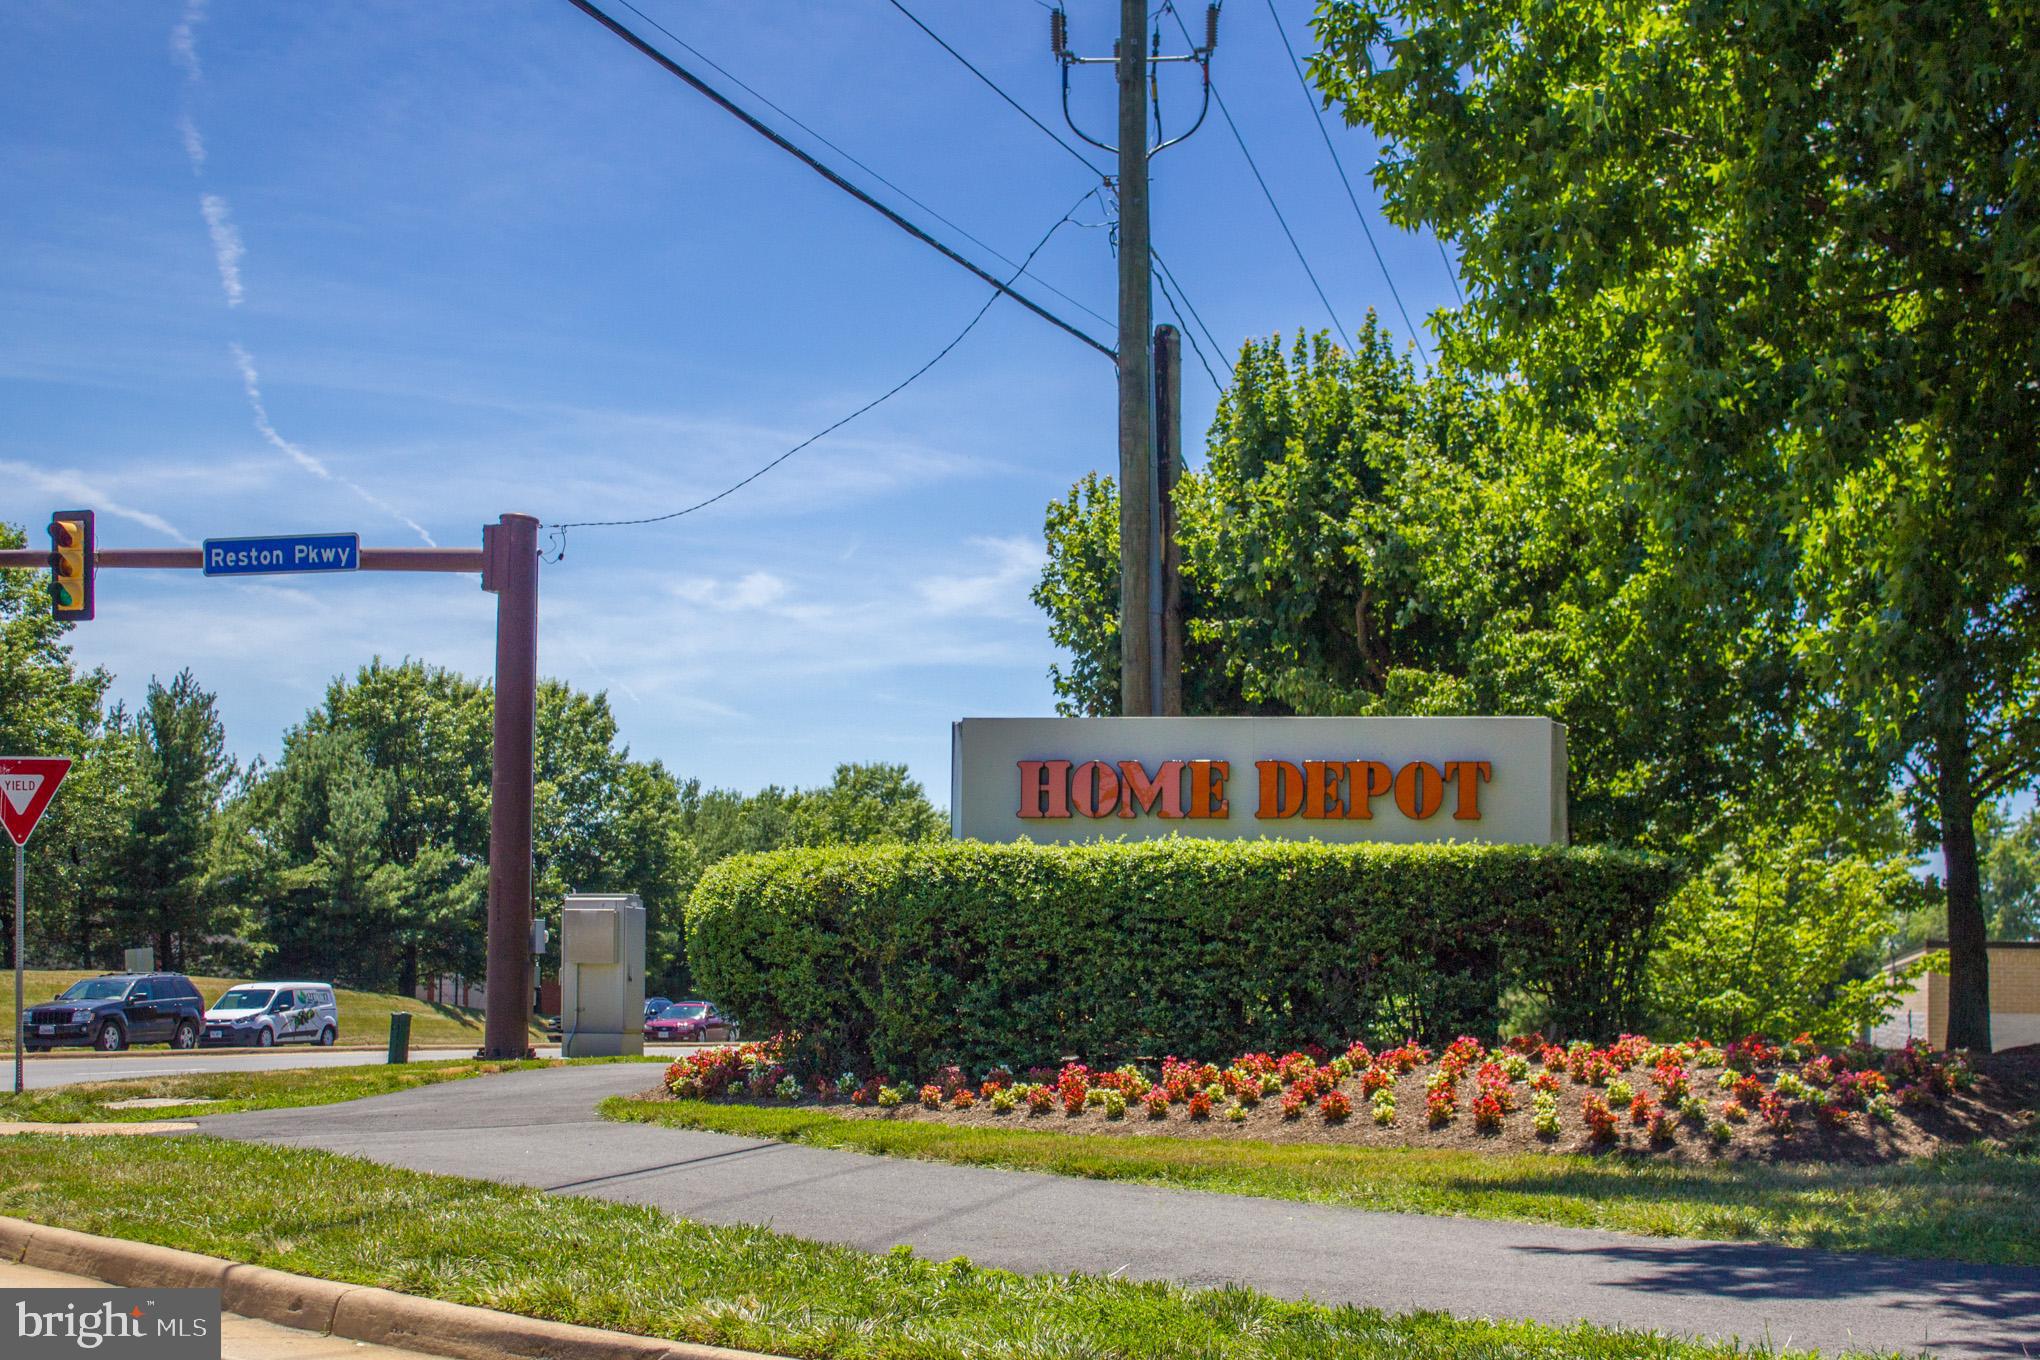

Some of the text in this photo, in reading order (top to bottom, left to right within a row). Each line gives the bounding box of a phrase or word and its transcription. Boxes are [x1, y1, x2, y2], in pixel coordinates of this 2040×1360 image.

[211, 545, 350, 567] Reston Pkwy
[4, 780, 36, 791] YIELD
[1016, 760, 1492, 820] HOME DEPOT
